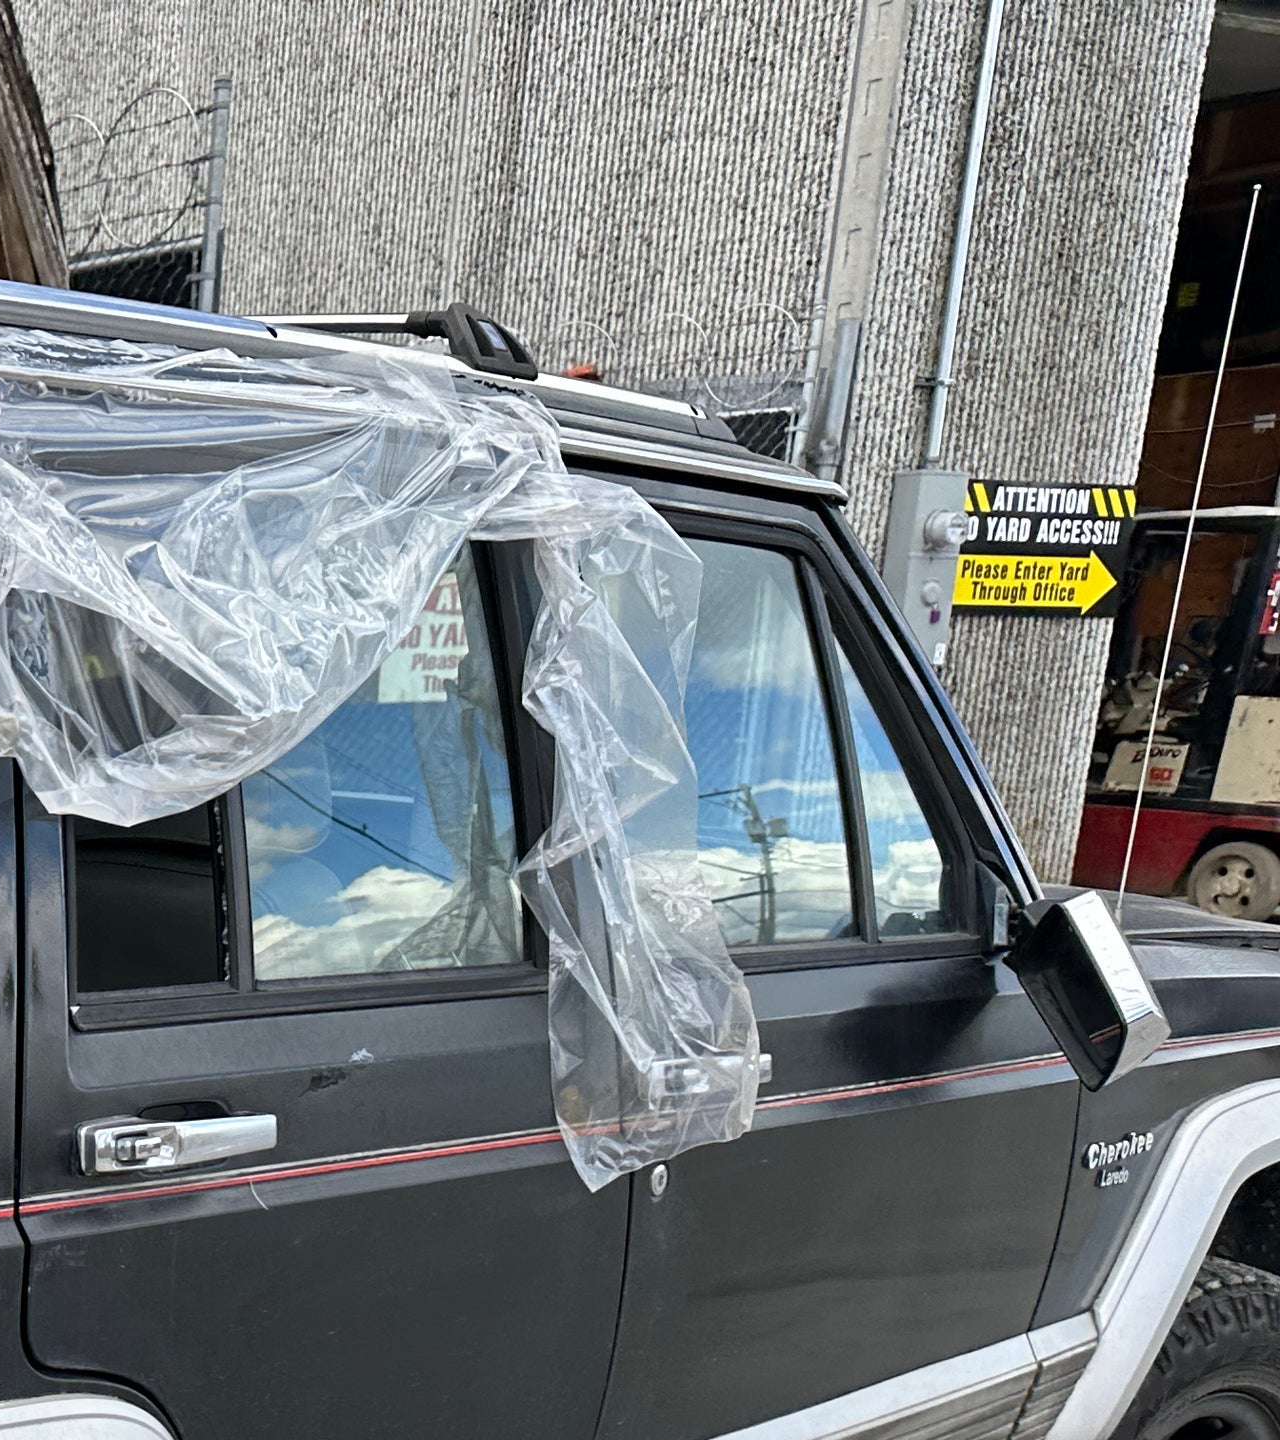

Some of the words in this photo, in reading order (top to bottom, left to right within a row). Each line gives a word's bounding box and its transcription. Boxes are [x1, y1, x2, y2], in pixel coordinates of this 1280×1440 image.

[993, 486, 1090, 515] ATTENTION
[987, 518, 1031, 542] YARD
[1036, 519, 1121, 545] ACCESS!!!
[961, 560, 1007, 580] Please
[1014, 561, 1051, 581] Enter
[1060, 563, 1089, 581] Yard
[971, 582, 1027, 604] Through
[1033, 583, 1076, 602] Office
[1087, 1131, 1154, 1170] Cherokee
[1099, 1166, 1129, 1187] Laredo
